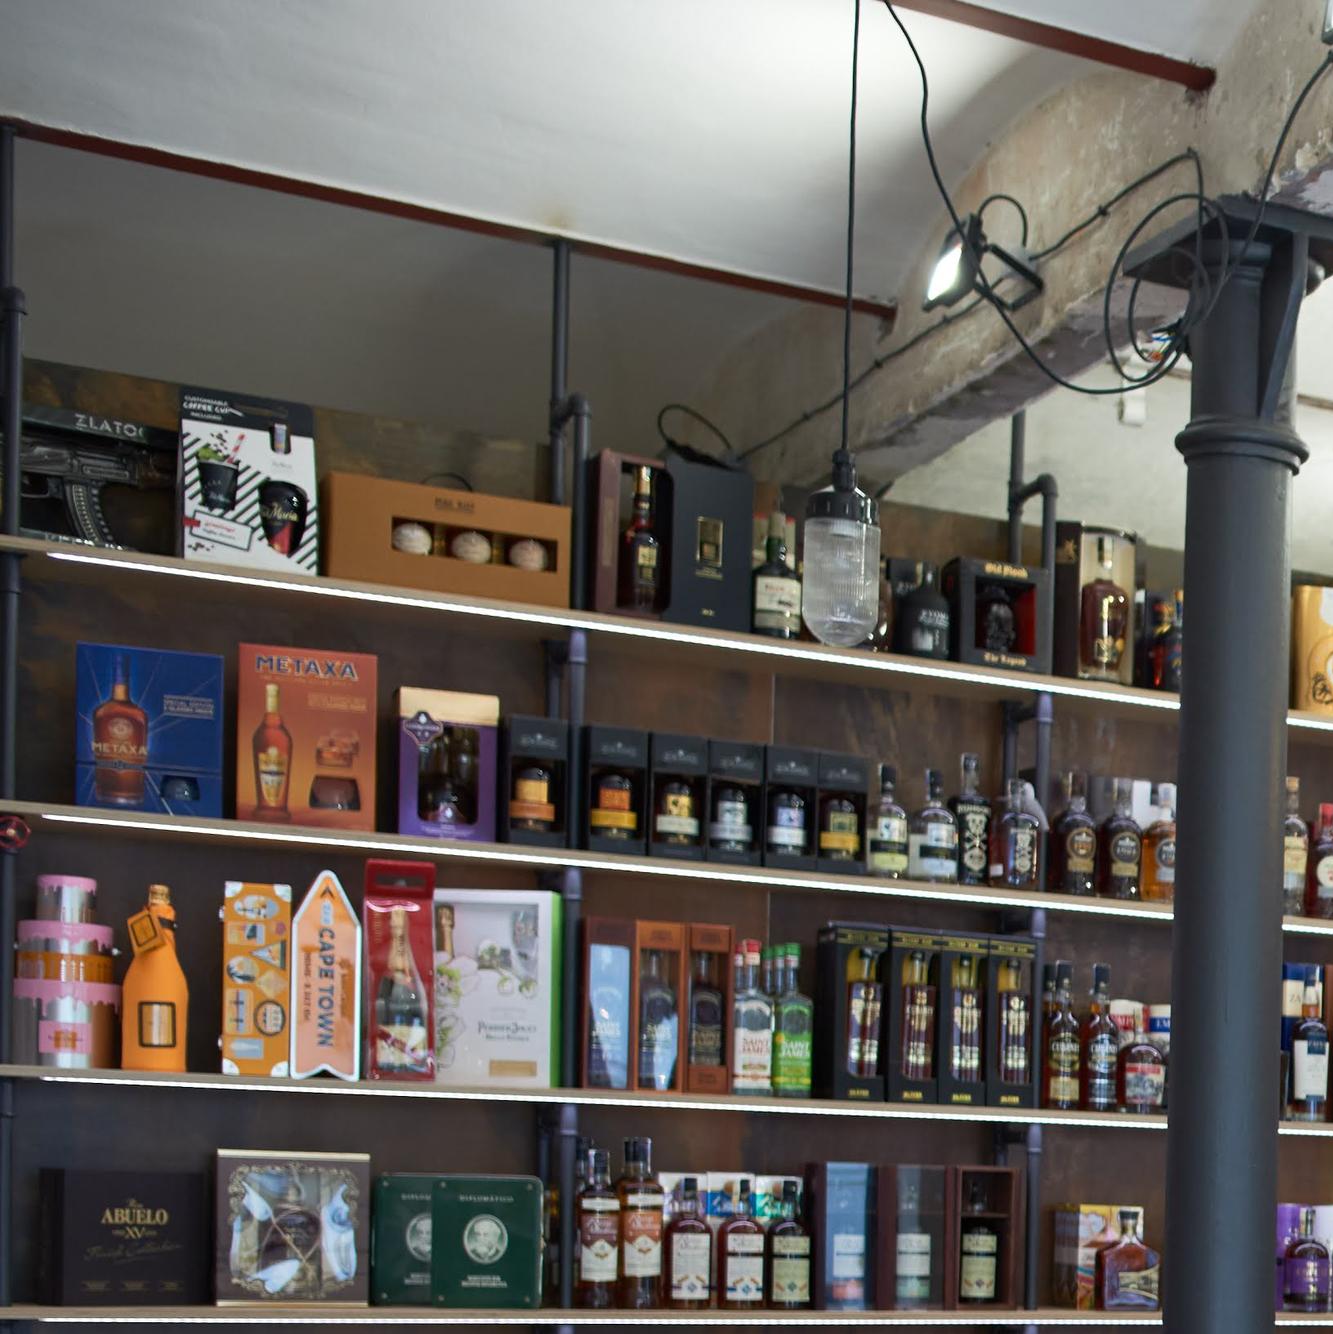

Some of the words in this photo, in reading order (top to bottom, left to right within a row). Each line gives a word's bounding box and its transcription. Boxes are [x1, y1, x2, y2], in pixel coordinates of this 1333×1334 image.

[255, 654, 360, 682] METAXA
[91, 740, 149, 757] METAXA
[317, 926, 336, 980] CAPE
[316, 983, 335, 1048] TOWN
[101, 1208, 169, 1225] ABUELO
[125, 1226, 145, 1240] XV
